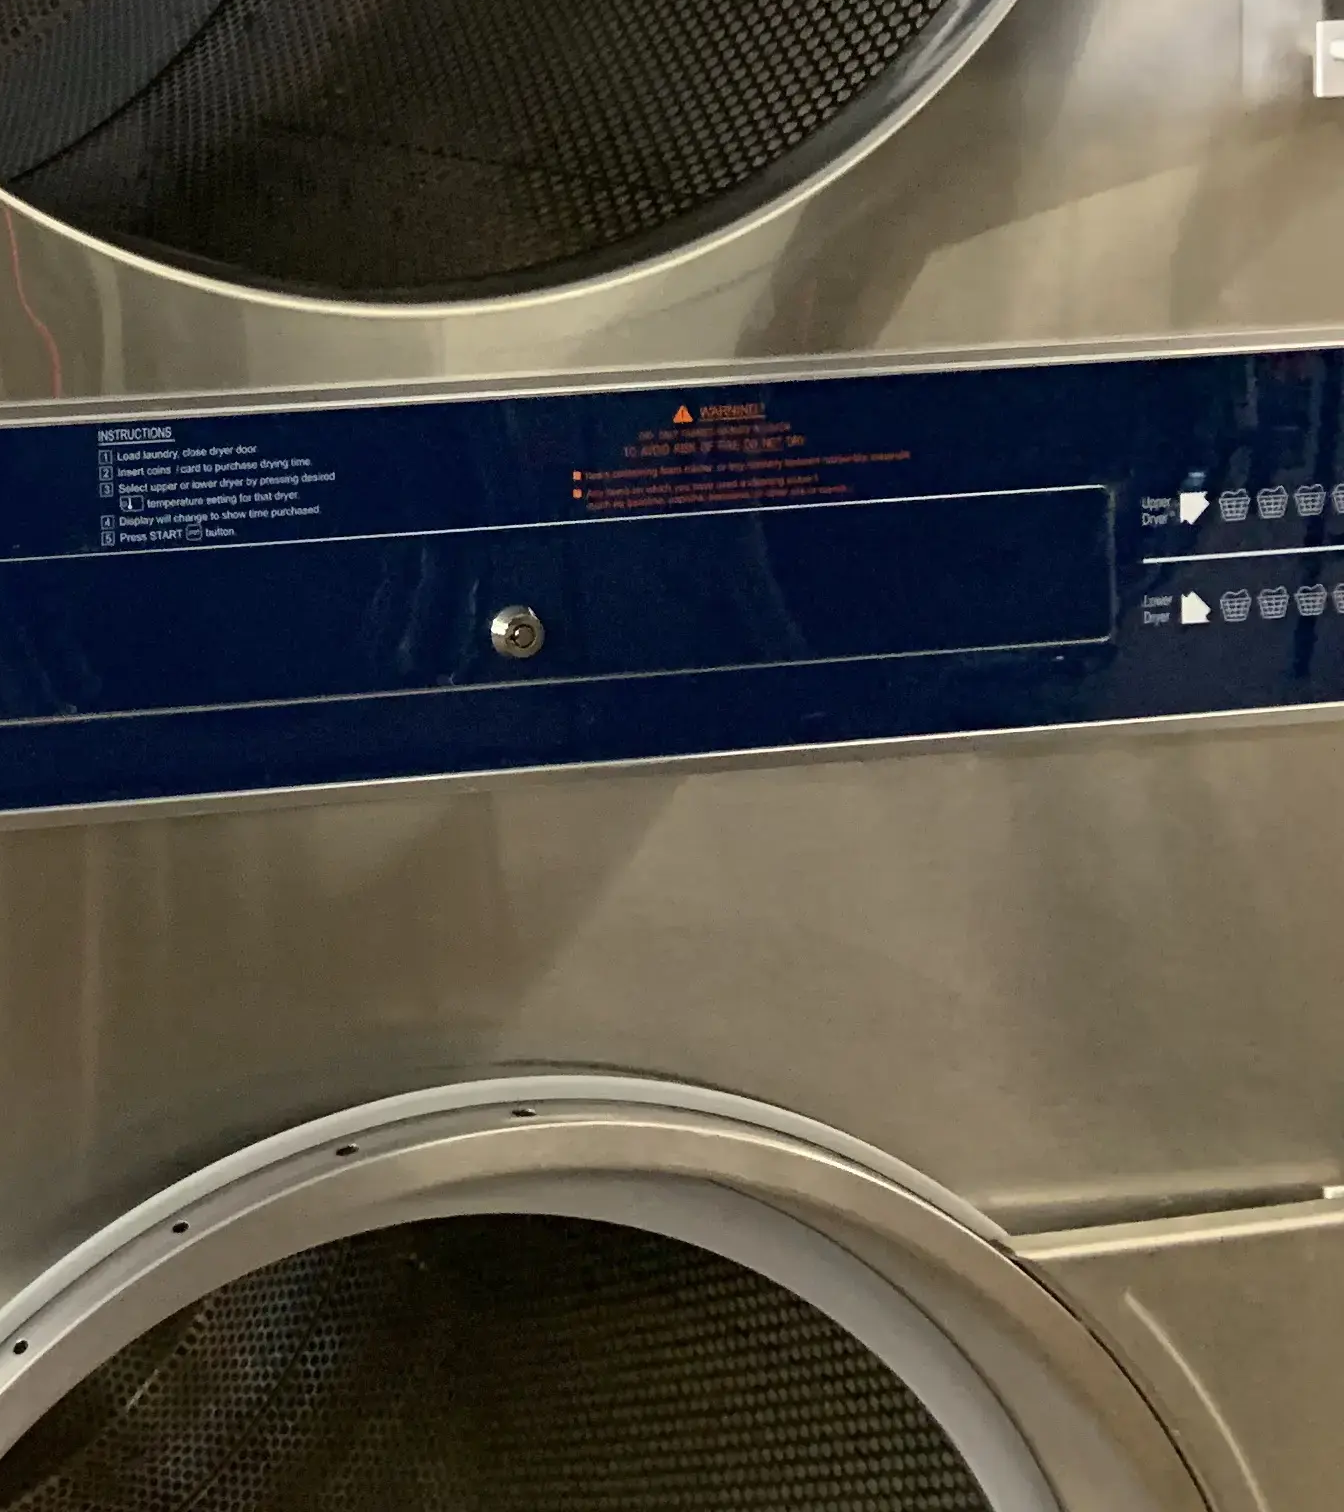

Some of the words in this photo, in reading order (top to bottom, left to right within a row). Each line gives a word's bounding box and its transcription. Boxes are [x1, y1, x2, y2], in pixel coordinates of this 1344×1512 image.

[98, 427, 172, 441] INSTRUCTIONS
[117, 451, 140, 461] Load
[182, 448, 207, 457] close
[209, 446, 233, 457] dryer
[118, 468, 144, 477] Insert
[147, 466, 171, 475] coins
[203, 464, 212, 472] to
[215, 461, 257, 473] purchase
[260, 459, 288, 469] drying
[119, 483, 147, 493] Select
[151, 483, 177, 493] upper
[192, 480, 217, 488] lower
[220, 478, 243, 489] dryer
[246, 478, 258, 487] by
[260, 475, 298, 486] pressing
[301, 472, 335, 482] desired
[147, 497, 203, 509] temperature
[207, 494, 237, 505] setting
[239, 493, 251, 502] for
[254, 492, 272, 501] that
[119, 517, 153, 527] Display
[156, 514, 171, 523] will
[173, 513, 207, 523] change
[210, 512, 219, 520] to
[222, 510, 246, 519] show
[249, 509, 268, 518] time
[120, 533, 147, 542] Press
[150, 529, 182, 540] START
